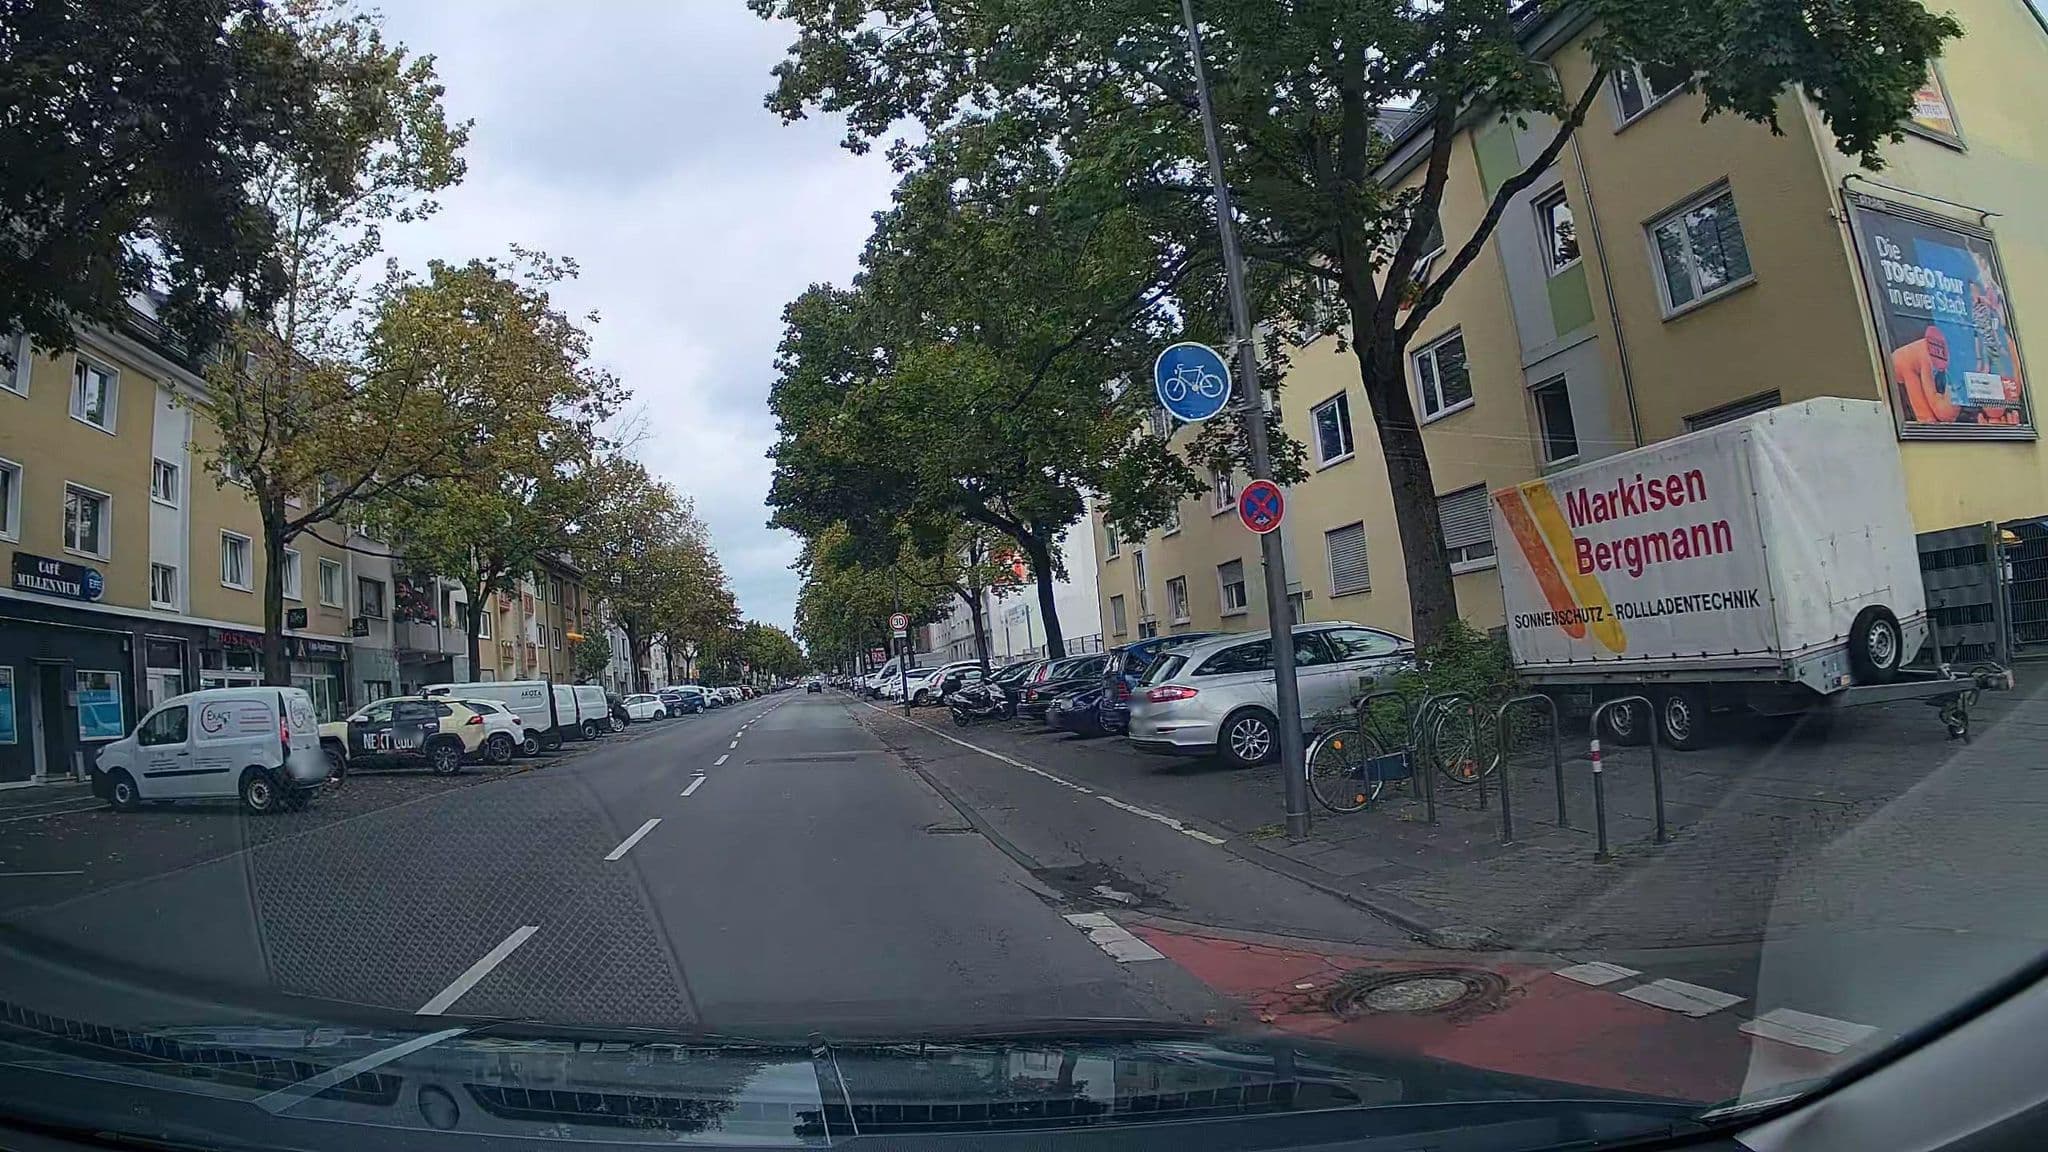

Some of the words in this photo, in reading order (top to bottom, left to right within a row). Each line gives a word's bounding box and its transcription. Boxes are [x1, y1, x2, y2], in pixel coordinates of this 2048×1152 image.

[1874, 235, 1901, 260] Die
[1880, 260, 1935, 289] TOGGO
[1934, 270, 1964, 295] Tour
[1887, 283, 1903, 305] in
[1903, 291, 1936, 310] eurer
[1937, 291, 1968, 316] Stadt
[1565, 468, 1707, 529] Markisen
[1573, 519, 1734, 578] Bergmann
[17, 573, 81, 596] MILLENNIUM
[38, 560, 61, 577] CAFÉ
[1514, 606, 1604, 629] SONNENSCHUTZ
[1616, 588, 1760, 620] ROLLLADENTECHNIK
[363, 733, 391, 750] NEXT
